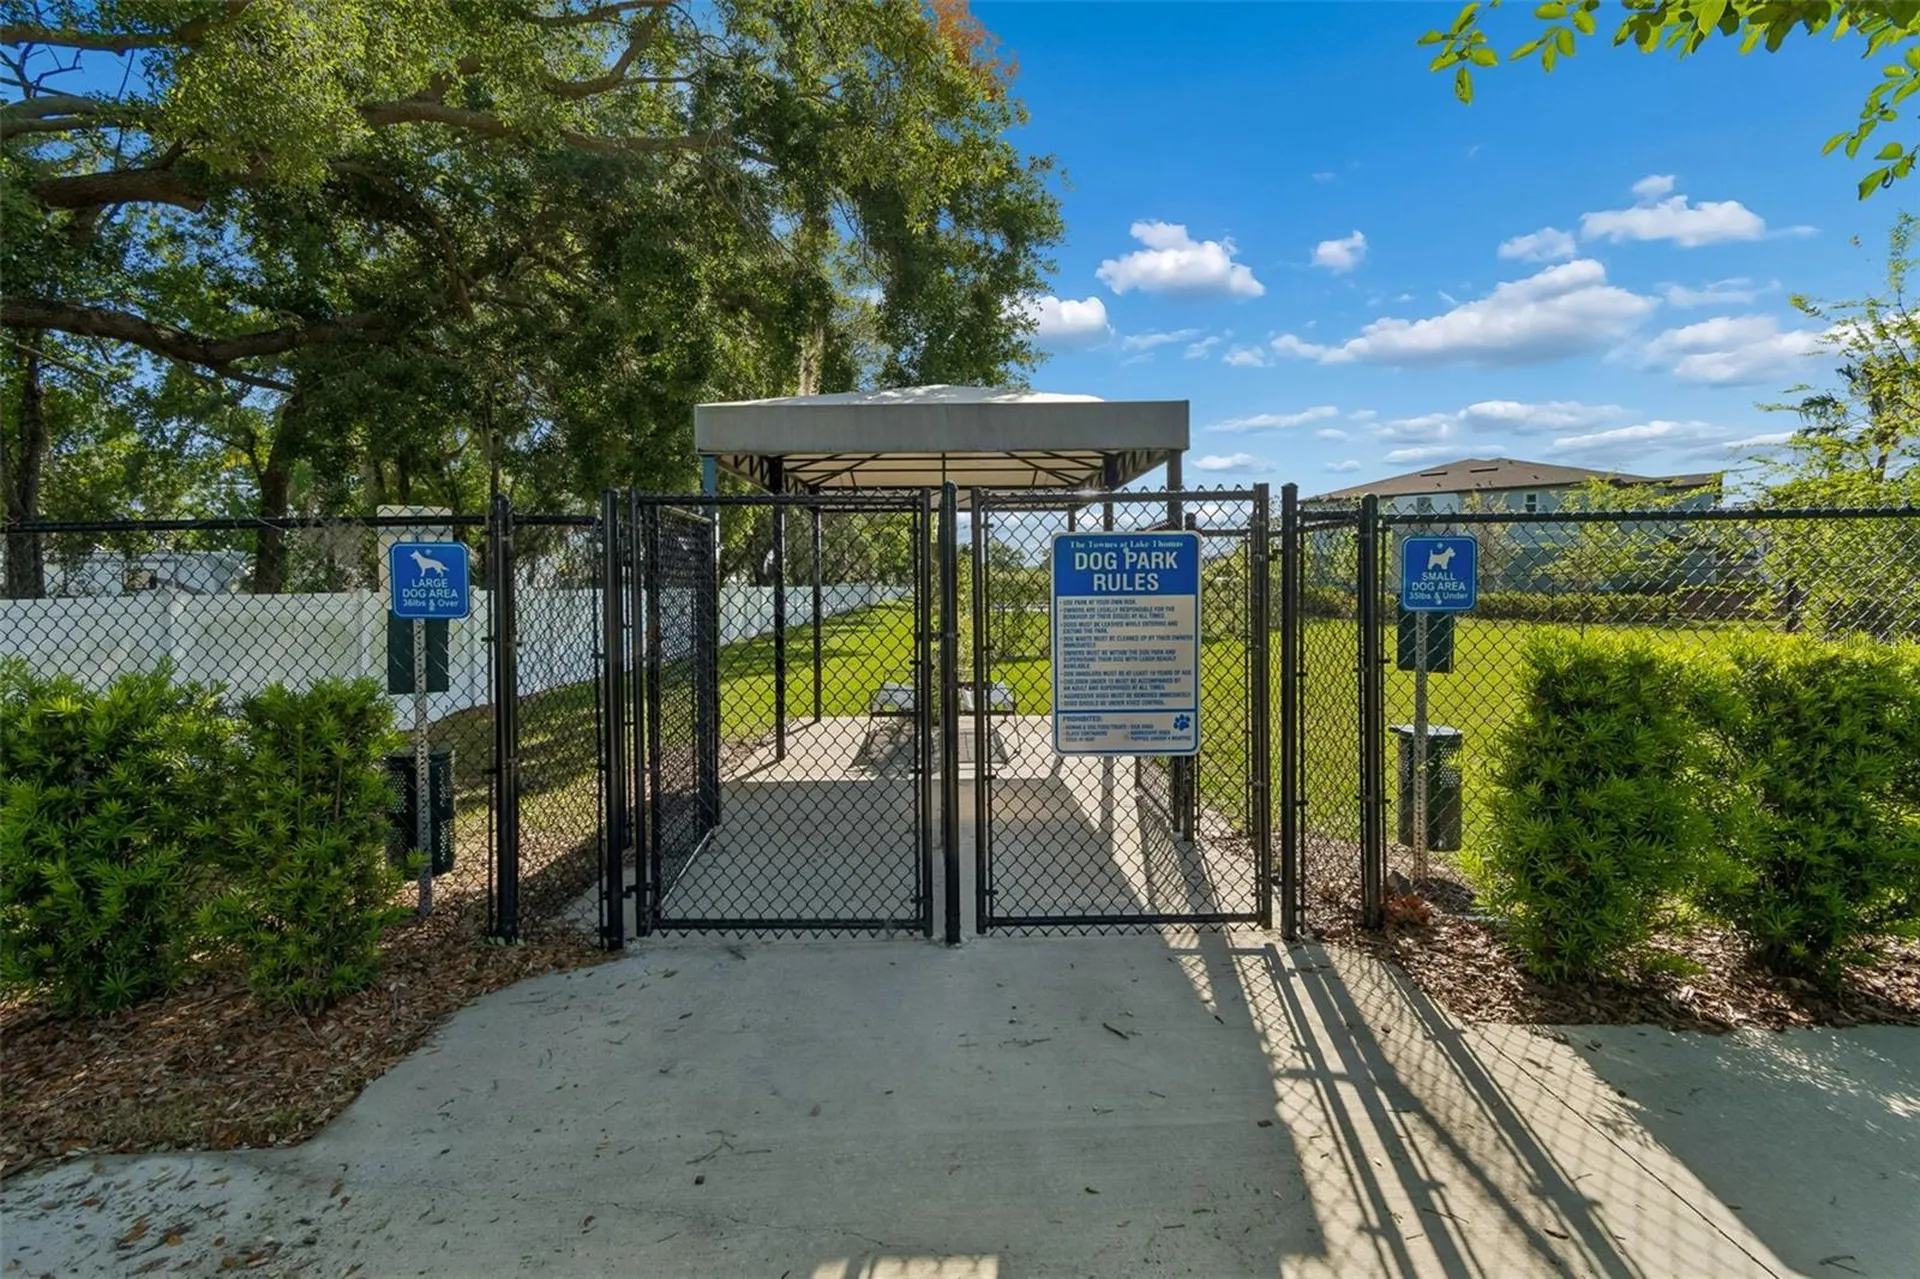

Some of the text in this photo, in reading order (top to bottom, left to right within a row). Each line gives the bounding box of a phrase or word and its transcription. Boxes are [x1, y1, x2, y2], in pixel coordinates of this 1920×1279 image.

[1075, 551, 1178, 570] DOG PARK
[1422, 572, 1456, 581] SMALL
[412, 578, 448, 588] LARGE
[1093, 573, 1159, 591] RULES
[1412, 582, 1466, 591] DOG AREA
[402, 589, 458, 598] DOG AREA
